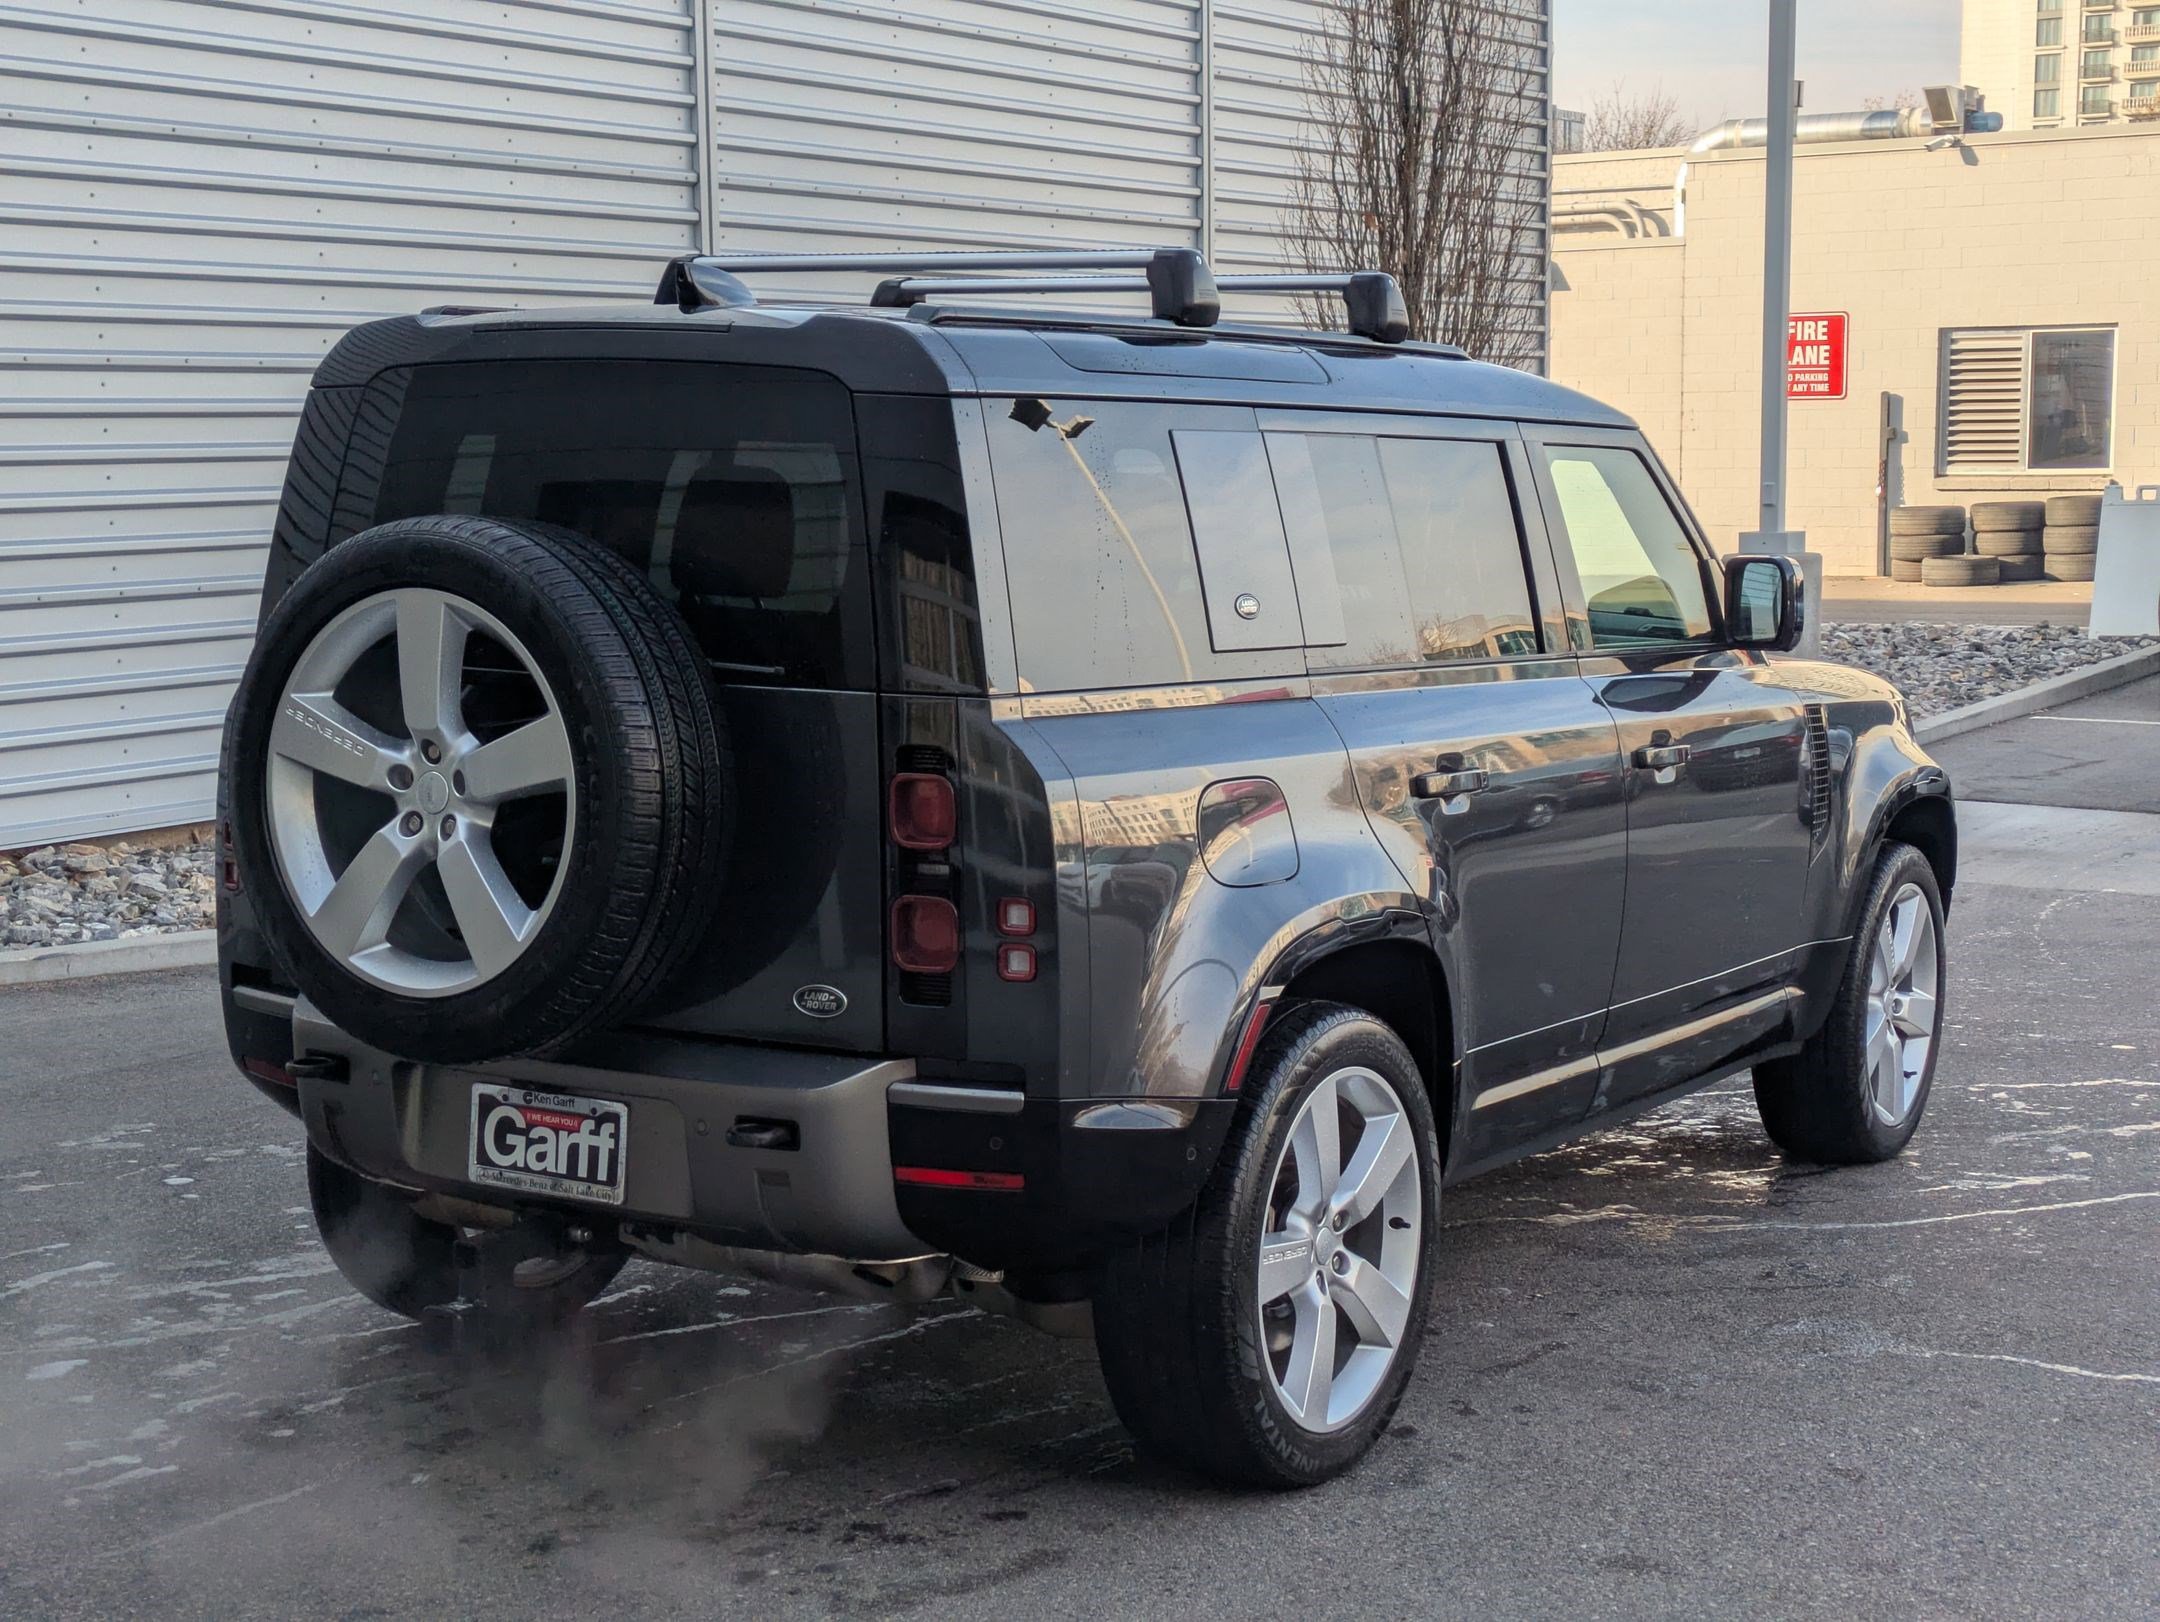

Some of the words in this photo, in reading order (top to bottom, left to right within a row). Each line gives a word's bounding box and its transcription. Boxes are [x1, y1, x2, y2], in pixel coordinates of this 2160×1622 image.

[1788, 320, 1828, 341] FIRE
[1788, 345, 1830, 365] ANE
[1795, 373, 1829, 382] PARKING
[1792, 383, 1808, 392] ANY
[1810, 383, 1830, 392] TIME
[534, 1093, 551, 1105] Ken
[553, 1095, 576, 1108] Garff
[532, 1113, 541, 1121] WE
[543, 1115, 560, 1124] HEAR
[561, 1117, 573, 1127] YOU
[484, 1105, 615, 1182] Garff
